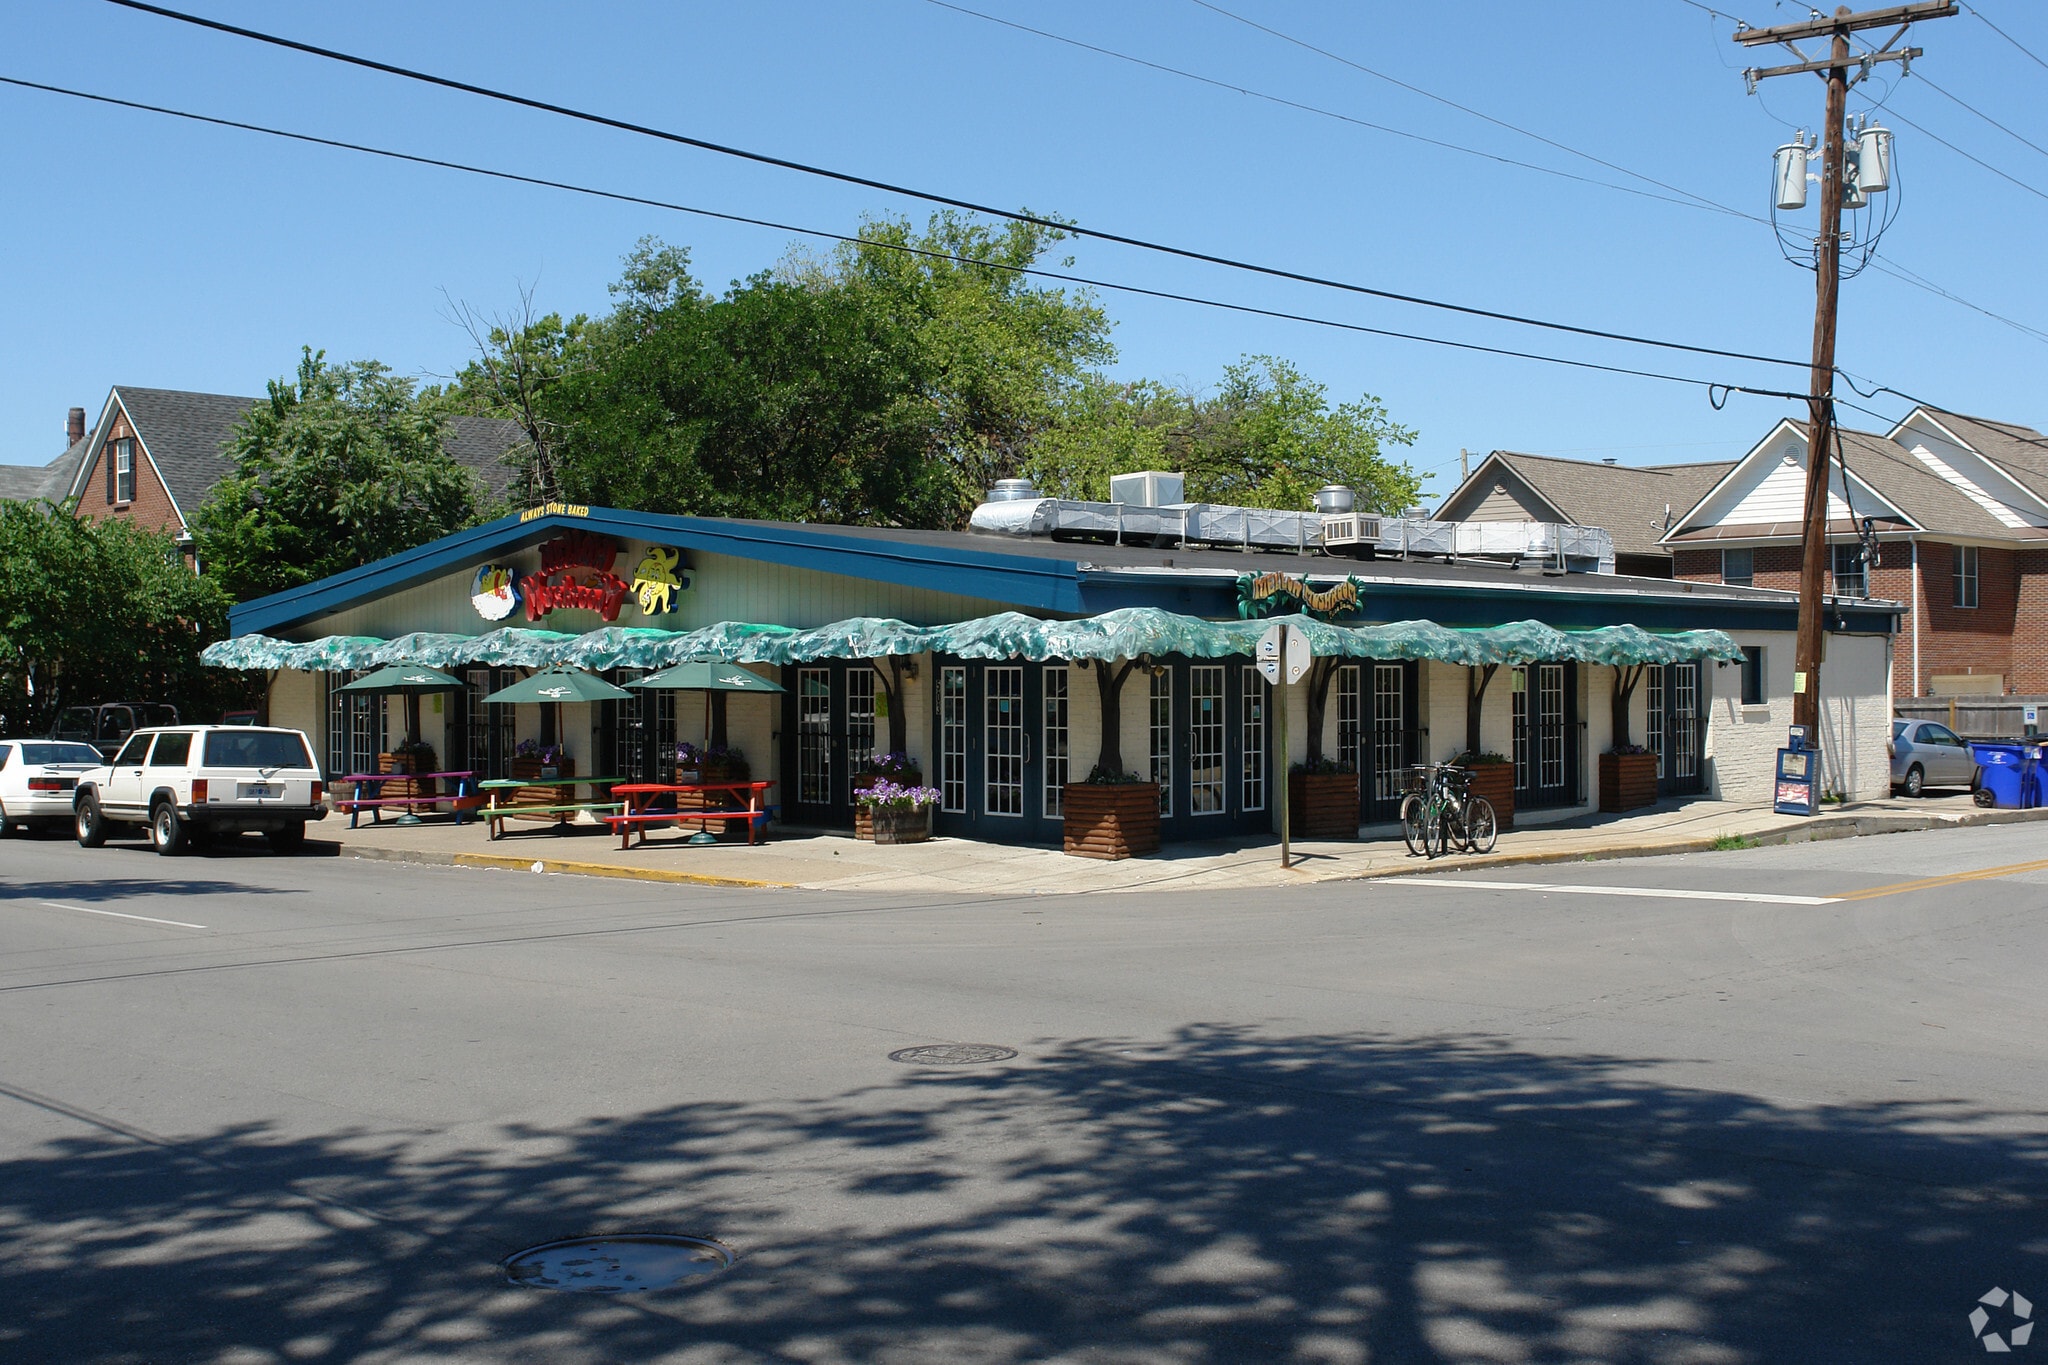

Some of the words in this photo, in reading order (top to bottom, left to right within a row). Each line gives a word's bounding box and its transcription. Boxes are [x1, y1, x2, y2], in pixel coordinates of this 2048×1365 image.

[521, 505, 545, 523] ALWAYS
[546, 501, 566, 514] STONE
[567, 504, 589, 517] BAKED
[1302, 581, 1357, 612] MUSHROOM
